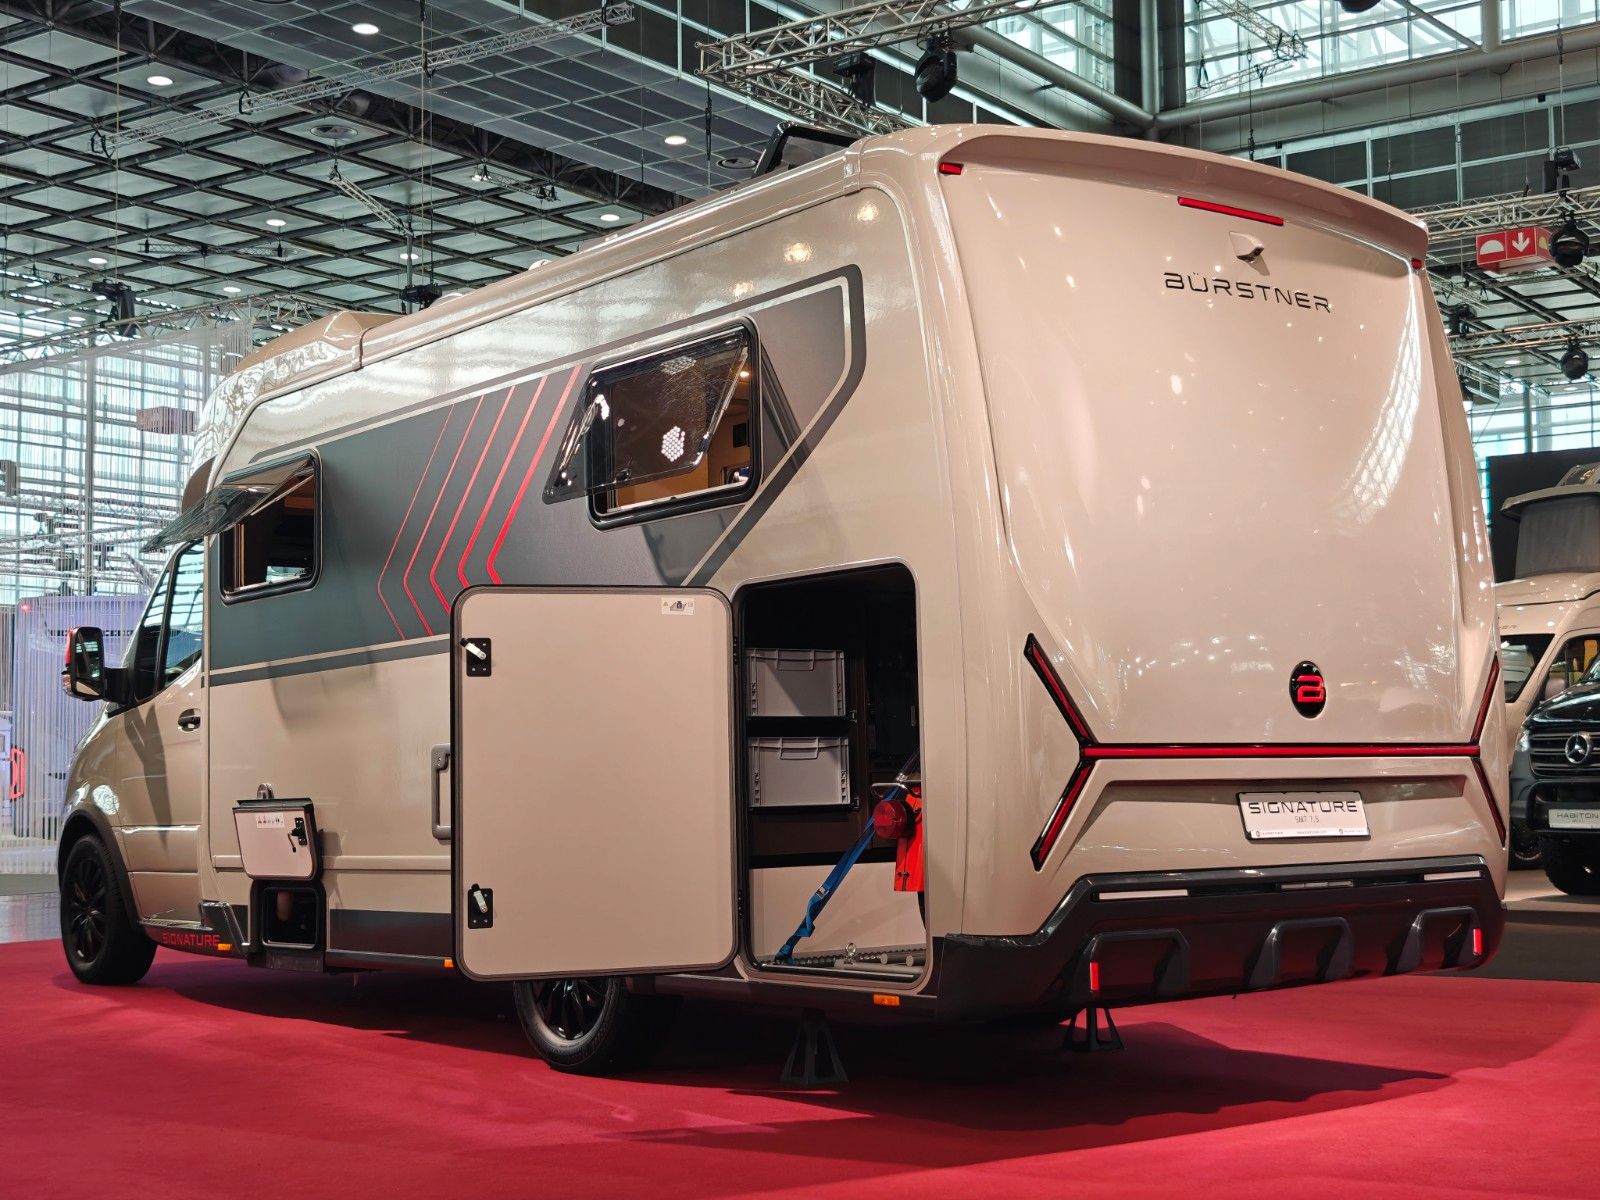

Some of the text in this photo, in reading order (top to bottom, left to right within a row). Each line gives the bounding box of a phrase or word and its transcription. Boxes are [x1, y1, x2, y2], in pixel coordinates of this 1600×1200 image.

[1164, 272, 1331, 313] BÜRSTNER
[1248, 801, 1358, 814] SIGNATURE
[162, 932, 220, 945] SIGNATURE
